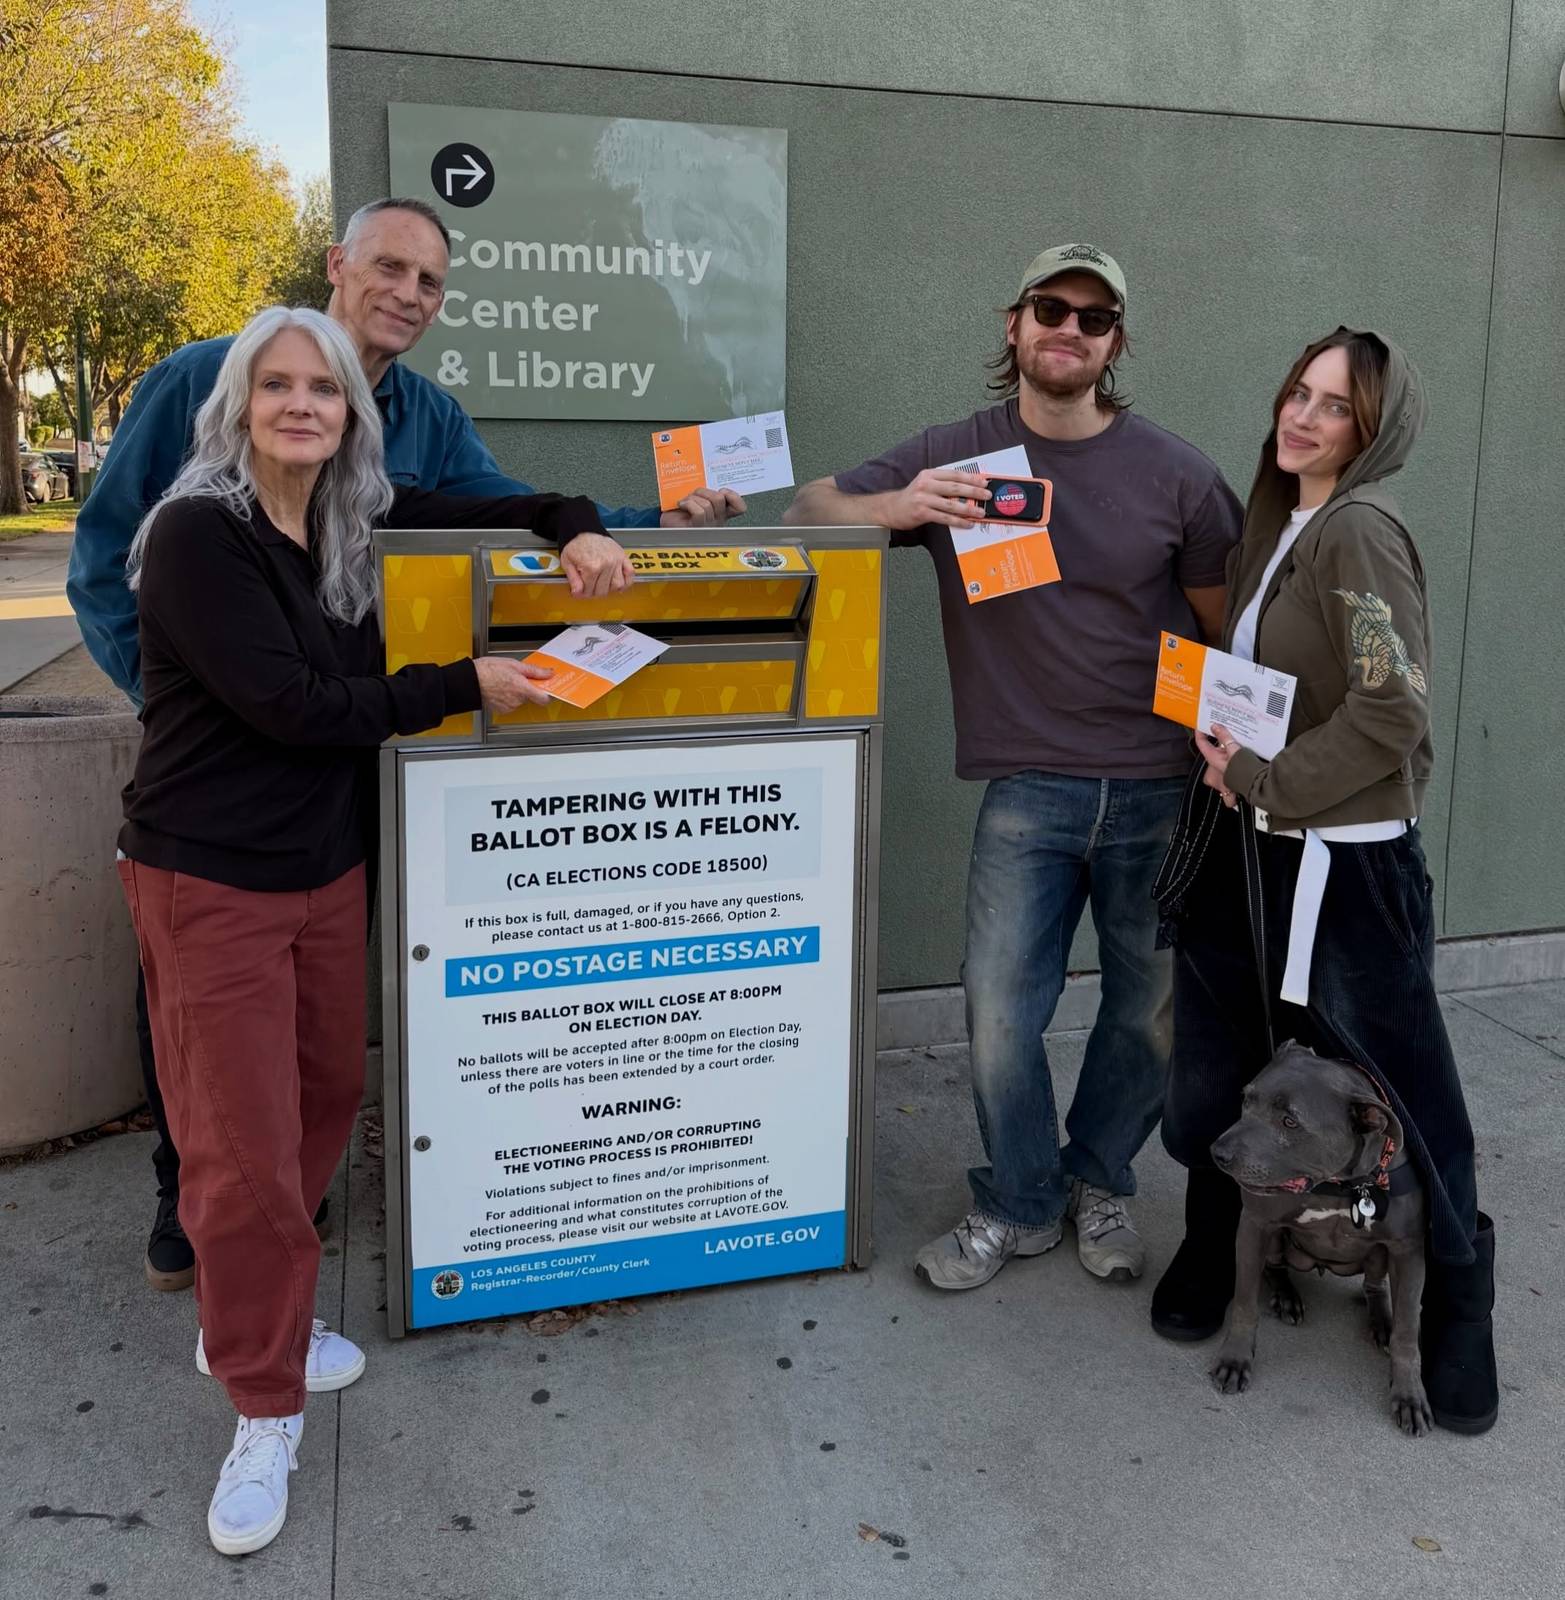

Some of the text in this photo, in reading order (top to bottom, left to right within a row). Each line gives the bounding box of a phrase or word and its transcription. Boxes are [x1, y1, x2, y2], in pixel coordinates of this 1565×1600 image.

[447, 229, 712, 285] Community
[437, 290, 599, 331] Center
[437, 349, 655, 397] & Library
[657, 551, 729, 559] BALLOT
[661, 561, 701, 569] BOX
[490, 783, 781, 818] TAMPERING WITH THIS
[471, 813, 800, 852] BALLOT BOX IS A FELONY.
[506, 854, 767, 890] (CA ELECTIONS CODE 18500)
[465, 892, 804, 928] If this box is full, damaged, or if you have any questions,
[491, 907, 780, 944] please contact us at 1-800-815-2666, Option 2.
[461, 936, 807, 986] NO POSTAGE NECESSARY
[482, 985, 781, 1025] THIS BALLOT BOX WILL CLOSE AT 8:00PM
[569, 1010, 702, 1033] ON ELECTION DAY.
[458, 1022, 801, 1067] No ballots will be accepted after 8:00pm on Election Day,
[460, 1037, 799, 1082] unless there are voters in line or the time for the closing
[487, 1054, 774, 1094] of the polls has been extended by a court order.
[581, 1096, 681, 1119] WARNING:
[494, 1119, 761, 1160] ELECTIONEERING AND/OR CORRUPTING
[503, 1135, 752, 1175] THE VOTING PROCESS IS PROHIBITED!
[485, 1155, 769, 1199] Violations subject to fines and/or imprisonment.
[469, 1188, 783, 1237] electioneering and what constitutes corruption of the
[486, 1174, 768, 1221] For additional information on the prohibitions of
[463, 1200, 788, 1252] voting process, please visit our website at LAVOTE.GOV.
[704, 1227, 820, 1254] LAVOTE.GOV
[471, 1254, 596, 1278] LOS ANGELES COUNTY
[471, 1264, 619, 1291] Registrar-Recorder/County
[622, 1258, 650, 1269] Clerk
